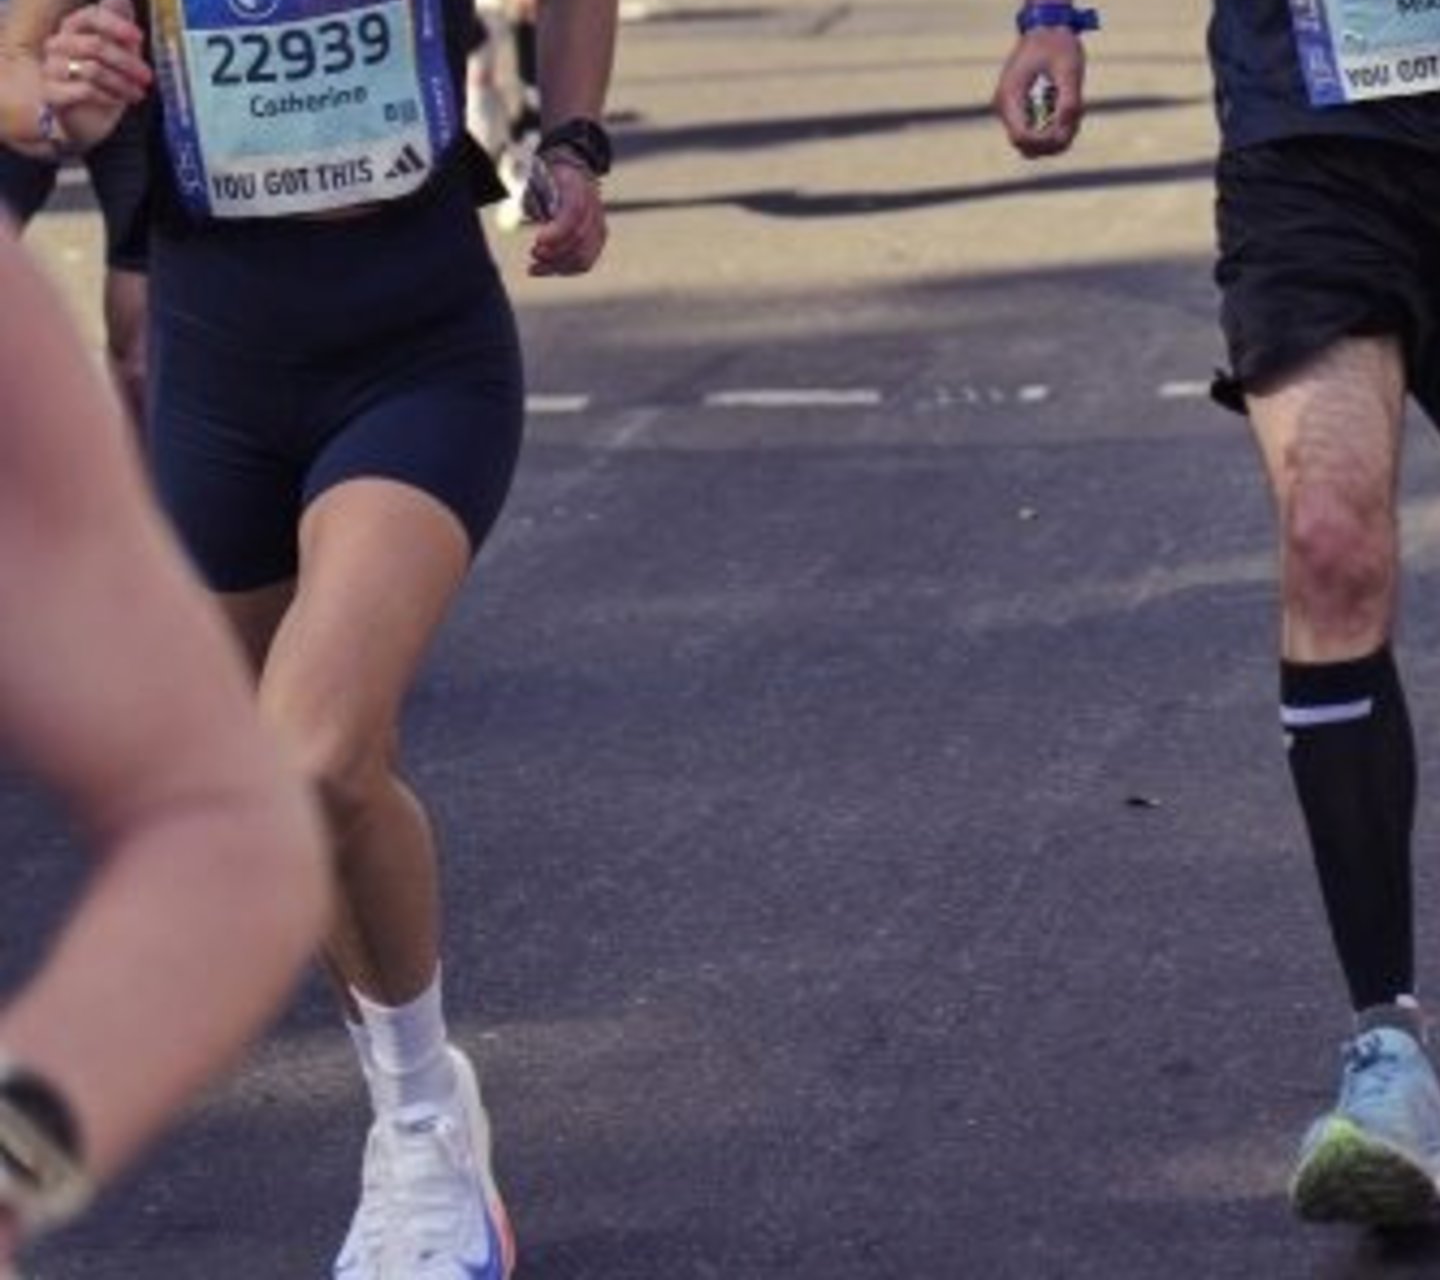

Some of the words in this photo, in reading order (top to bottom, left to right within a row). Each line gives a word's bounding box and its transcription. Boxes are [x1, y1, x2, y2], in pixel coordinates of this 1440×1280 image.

[206, 12, 391, 86] 22939
[1345, 63, 1389, 87] YOU
[1396, 55, 1439, 83] GOT
[250, 85, 369, 119] Catherine
[211, 172, 256, 200] YOU
[263, 167, 310, 196] GOT
[316, 157, 374, 191] THIS
